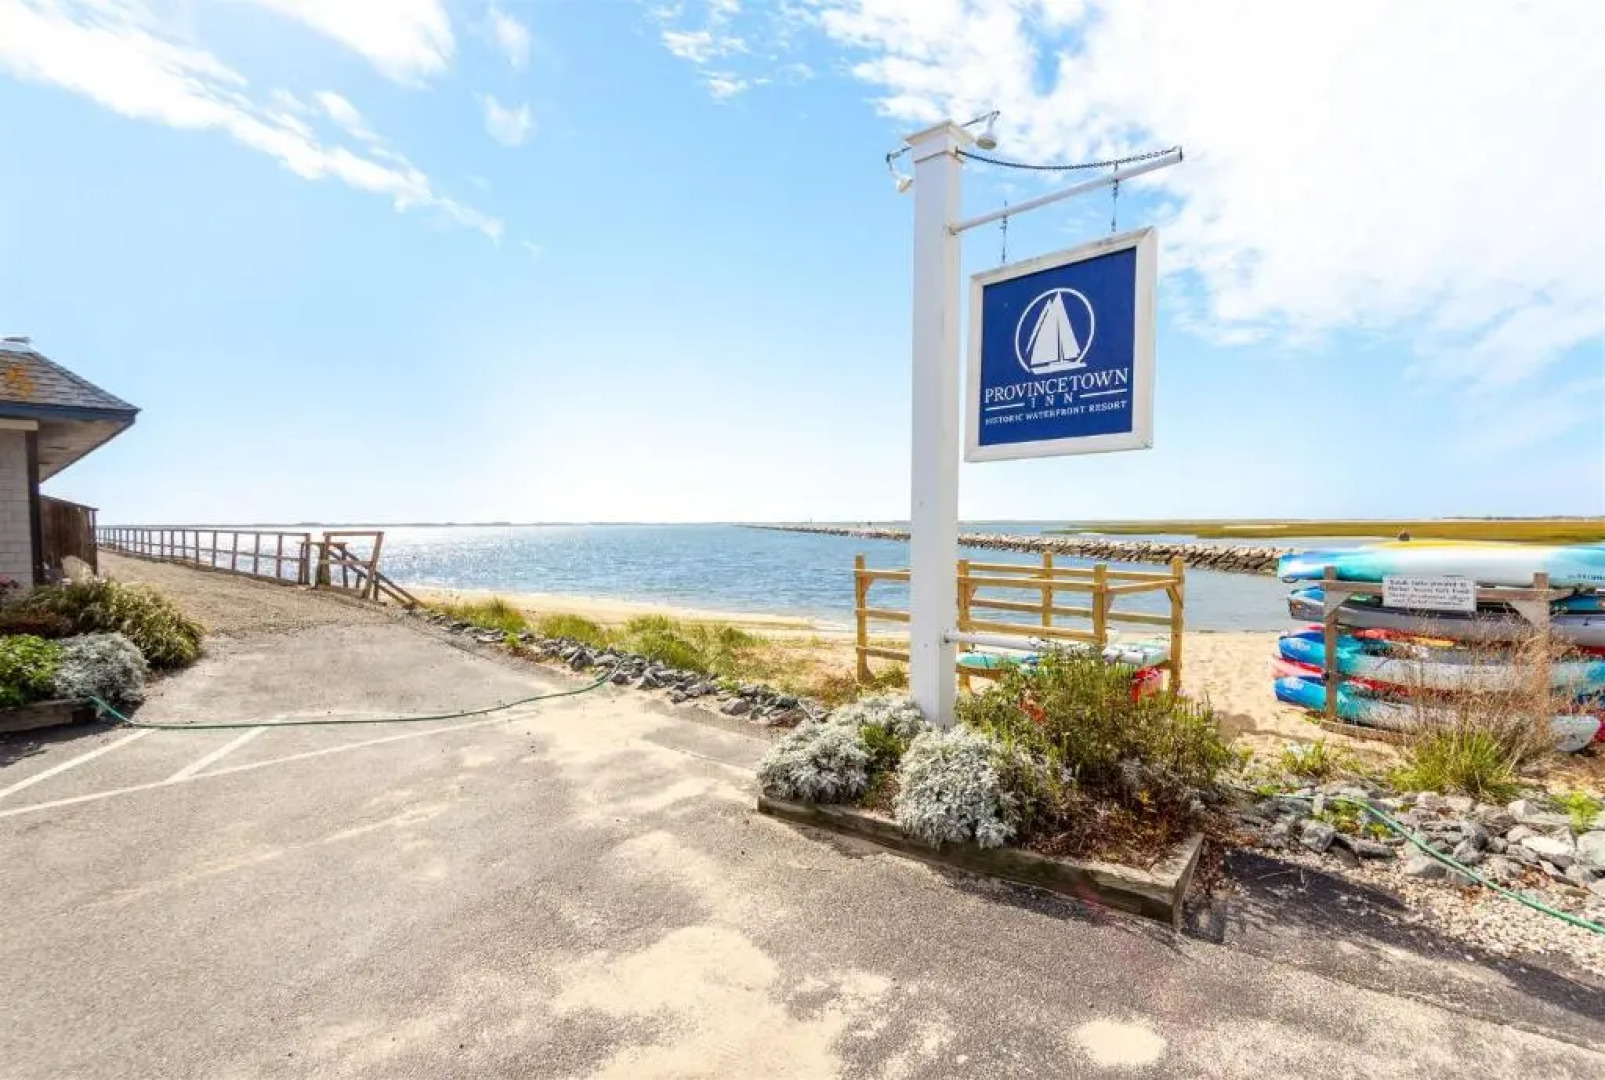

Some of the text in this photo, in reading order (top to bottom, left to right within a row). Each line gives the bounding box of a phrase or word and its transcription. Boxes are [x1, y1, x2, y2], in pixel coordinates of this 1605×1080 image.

[984, 368, 1129, 403] PROVINCETOWN
[985, 400, 1127, 425] HISTORIC WATERFRONT RESORT
[1030, 392, 1073, 408] INN
